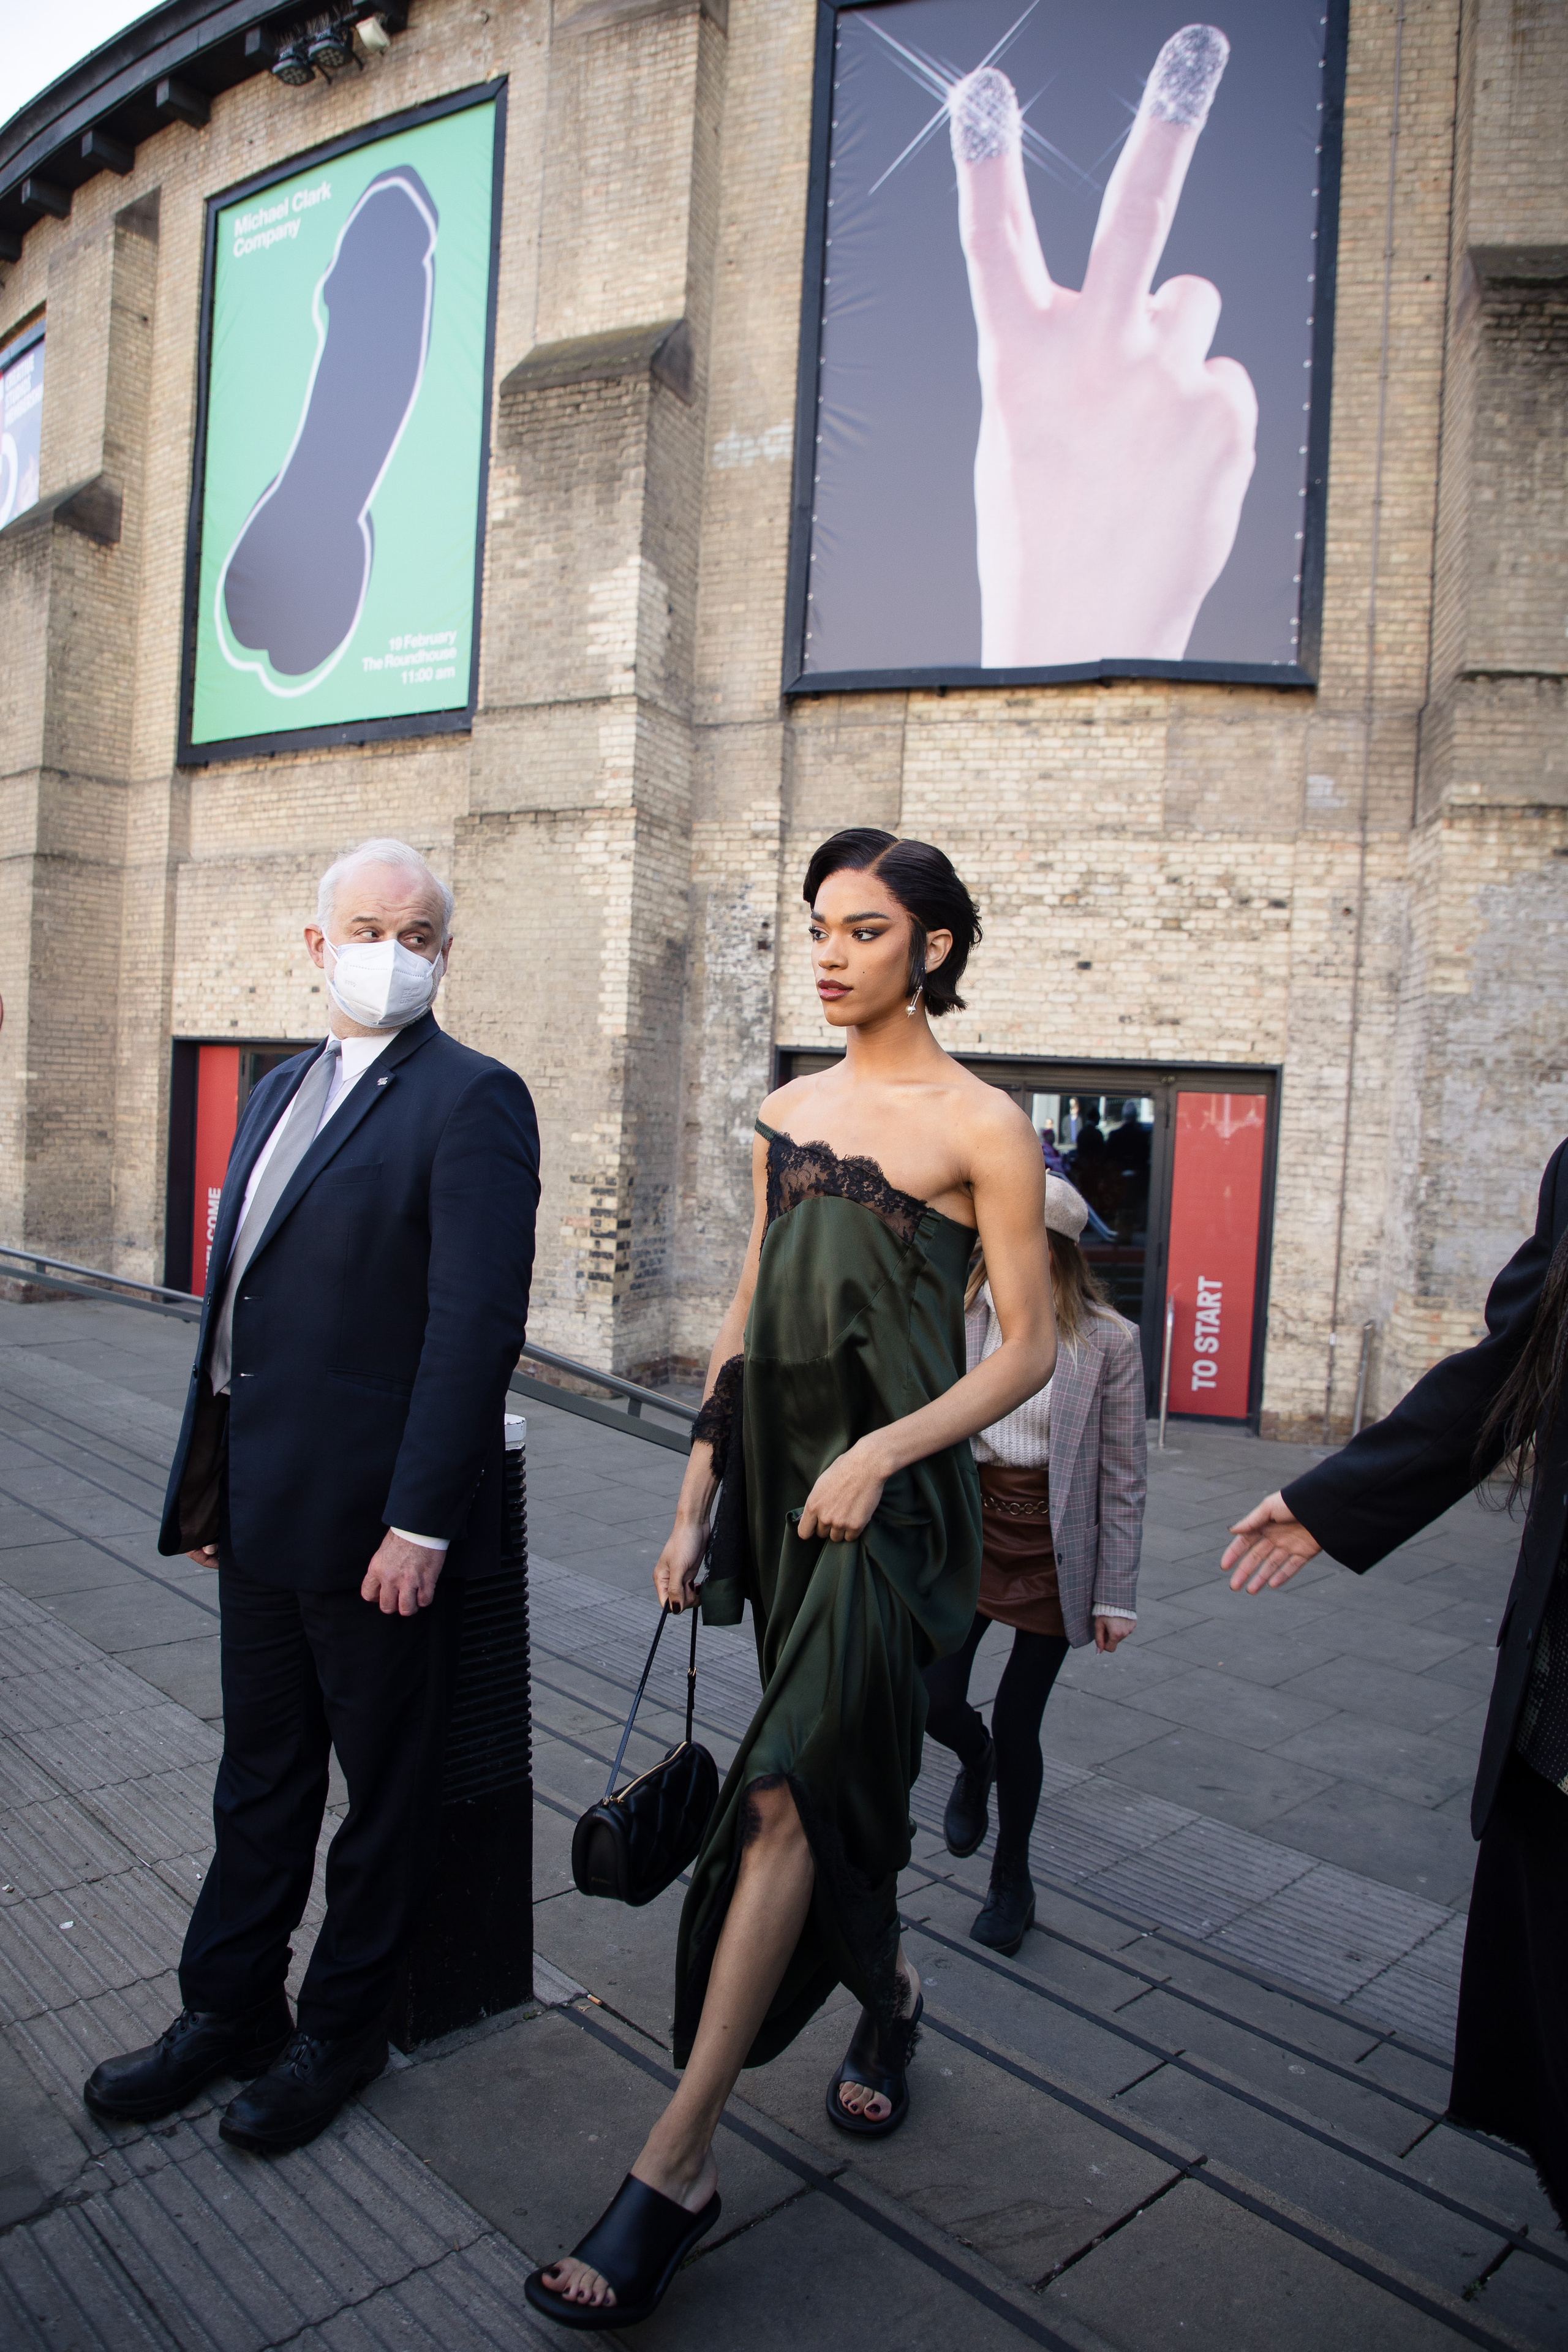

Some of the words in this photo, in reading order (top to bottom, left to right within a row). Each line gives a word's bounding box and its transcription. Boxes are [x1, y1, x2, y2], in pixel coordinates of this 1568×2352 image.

[234, 197, 289, 238] Michael
[292, 181, 331, 213] Clark
[233, 217, 301, 258] Company
[361, 656, 383, 672] The
[384, 647, 457, 669] Roundhouse
[389, 636, 403, 652] 19
[403, 630, 457, 649] February
[401, 666, 434, 684] 11:00
[434, 666, 456, 680] am
[205, 1187, 222, 1279] COME
[1194, 1275, 1223, 1354] START
[1191, 1359, 1218, 1392] TO
